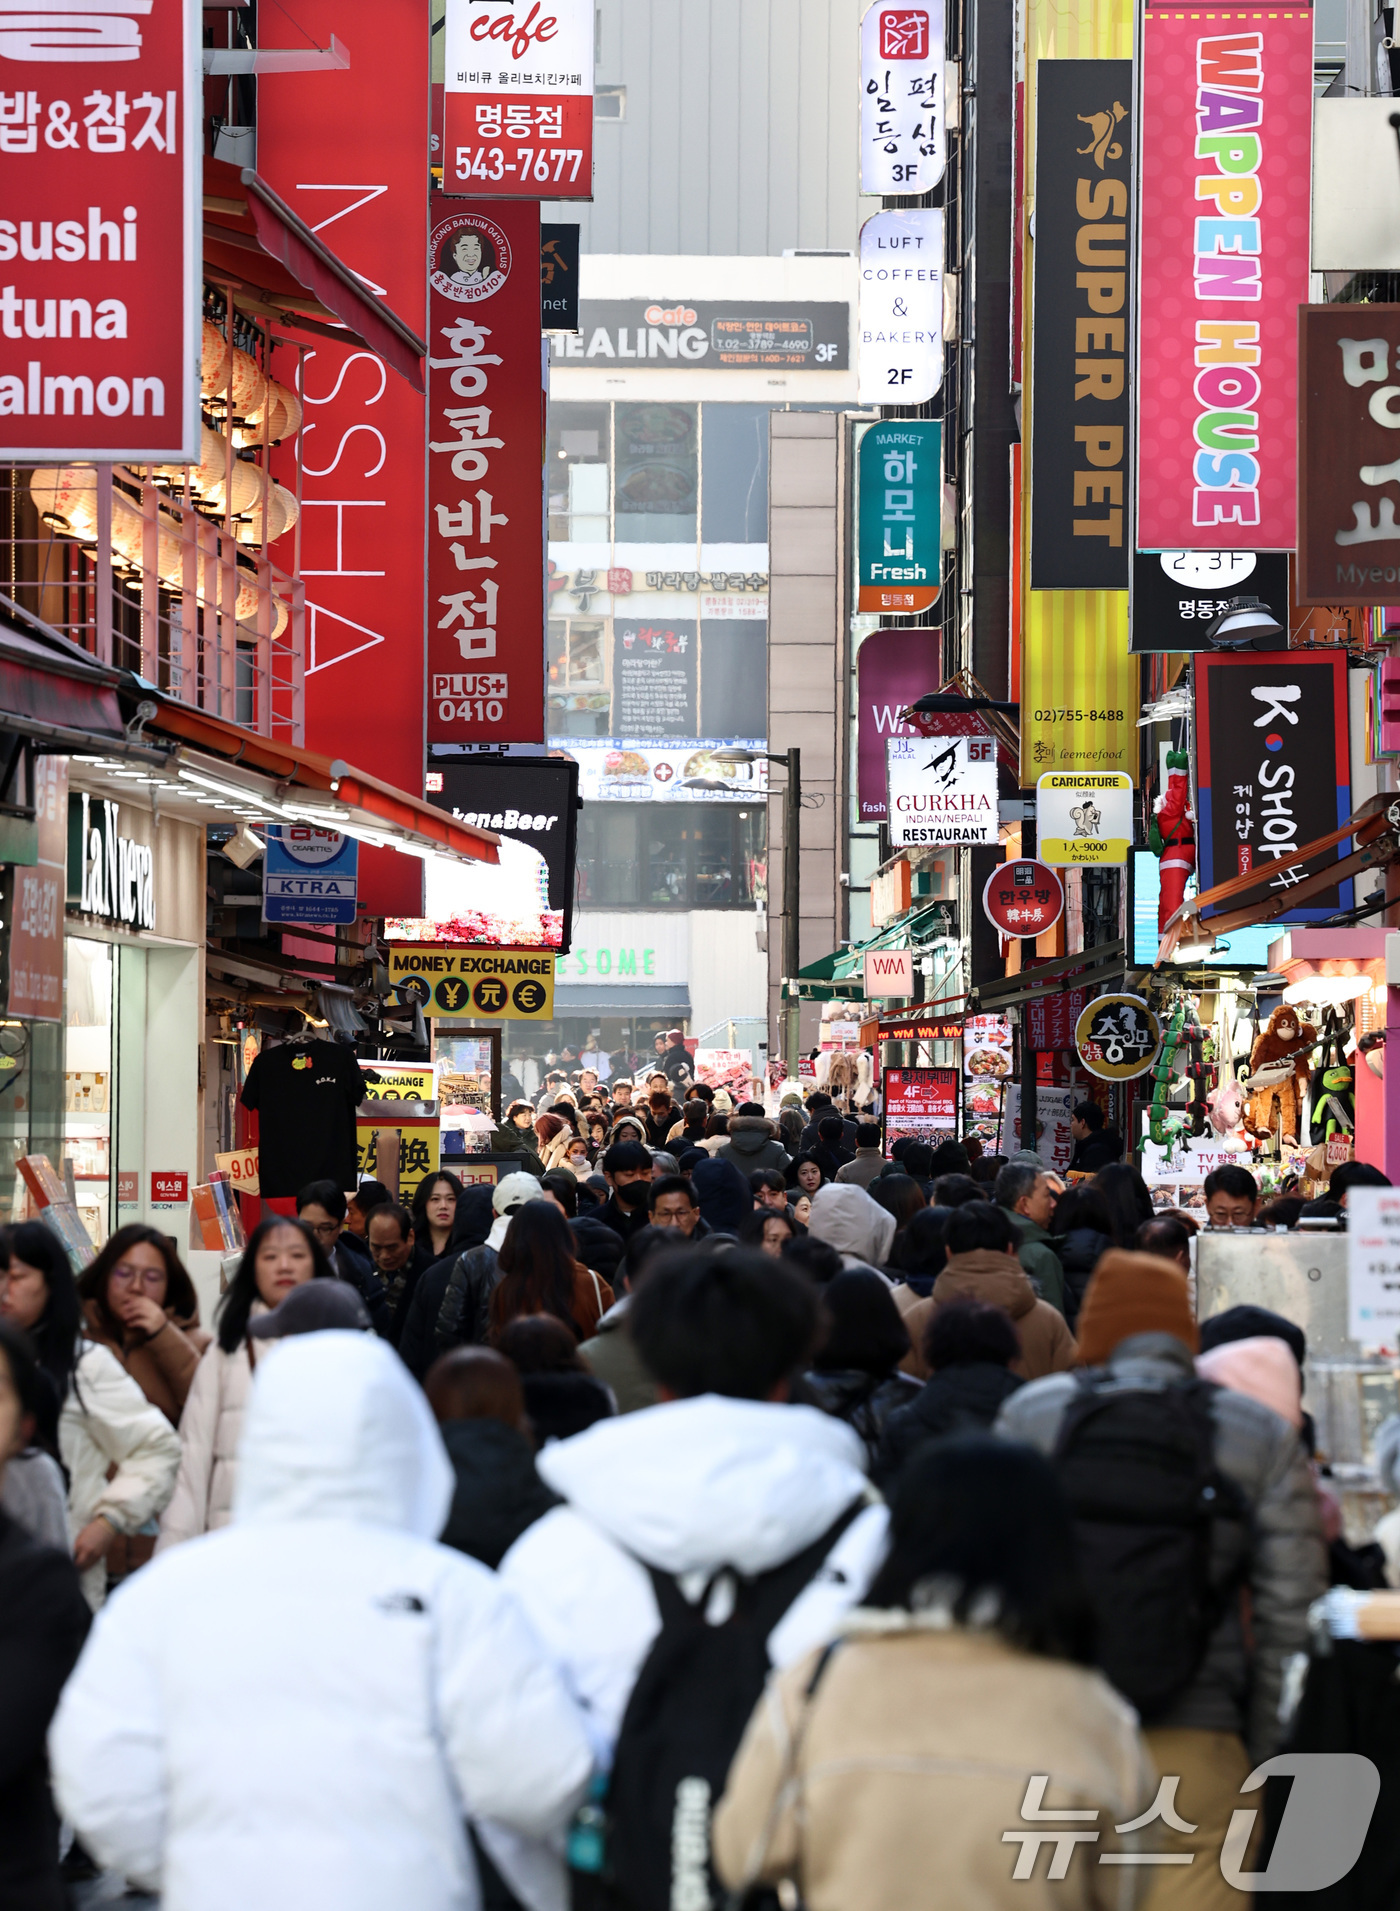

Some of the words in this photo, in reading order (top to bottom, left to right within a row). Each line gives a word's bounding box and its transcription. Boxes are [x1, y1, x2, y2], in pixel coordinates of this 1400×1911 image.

[470, 1, 558, 60] cafe
[457, 71, 492, 84] 비비큐
[498, 71, 582, 86] 올리브치킨카페
[0, 90, 176, 154] 밥&참치
[475, 104, 563, 139] 명동점
[455, 146, 583, 183] 543-7677
[892, 164, 918, 182] 3F
[1194, 32, 1263, 301] WAPPEN
[0, 206, 138, 261] sushi
[452, 218, 489, 230] BANJUM
[487, 227, 505, 246] 0410
[499, 246, 508, 270] PLUS
[878, 237, 924, 249] LUFT
[863, 269, 938, 281] COFFEE
[1075, 178, 1128, 402] SUPER
[1, 286, 128, 339] tuna
[543, 298, 567, 311] net
[892, 297, 908, 317] &
[645, 305, 698, 326] Cafe
[551, 326, 709, 360] HEALING
[863, 331, 937, 343] BAKERY
[814, 343, 838, 362] 3F
[887, 369, 913, 385] 2F
[1193, 320, 1261, 527] HOUSE
[876, 433, 924, 446] MARKET
[429, 317, 509, 660] 홍콩반점
[1073, 425, 1124, 548] PET
[882, 450, 918, 561] 하모니
[870, 563, 927, 580] Fresh
[881, 594, 914, 606] 명동점
[434, 675, 506, 697] PLUS+
[438, 700, 503, 722] 0410
[1251, 684, 1301, 728] K
[1034, 709, 1124, 723] 02)755-8488
[969, 743, 992, 761] 5F
[1060, 748, 1125, 763] leemeefood
[1052, 777, 1119, 788] CARICATURE
[896, 793, 992, 812] GURKHA
[906, 813, 983, 824] INDIAN/NEPALI
[1232, 785, 1254, 840] 케이샵
[903, 828, 988, 842] RESTAURANT
[1072, 854, 1099, 862] かわいい
[281, 880, 342, 895] KTRA
[999, 889, 1051, 906] 한우방
[1006, 907, 1045, 923] 韓牛房
[1021, 924, 1032, 933] 3F
[393, 955, 456, 973] MONEY
[460, 957, 551, 975] EXCHANGE
[873, 958, 905, 975] WM
[917, 1026, 939, 1038] WM
[1081, 1044, 1103, 1061] 명동
[903, 1085, 921, 1098] 4F
[1334, 1134, 1345, 1142] SALE
[1197, 1153, 1214, 1164] TV
[1217, 1153, 1237, 1164] 방영
[1327, 1145, 1349, 1162] 2,000
[156, 1180, 182, 1192] 에스원
